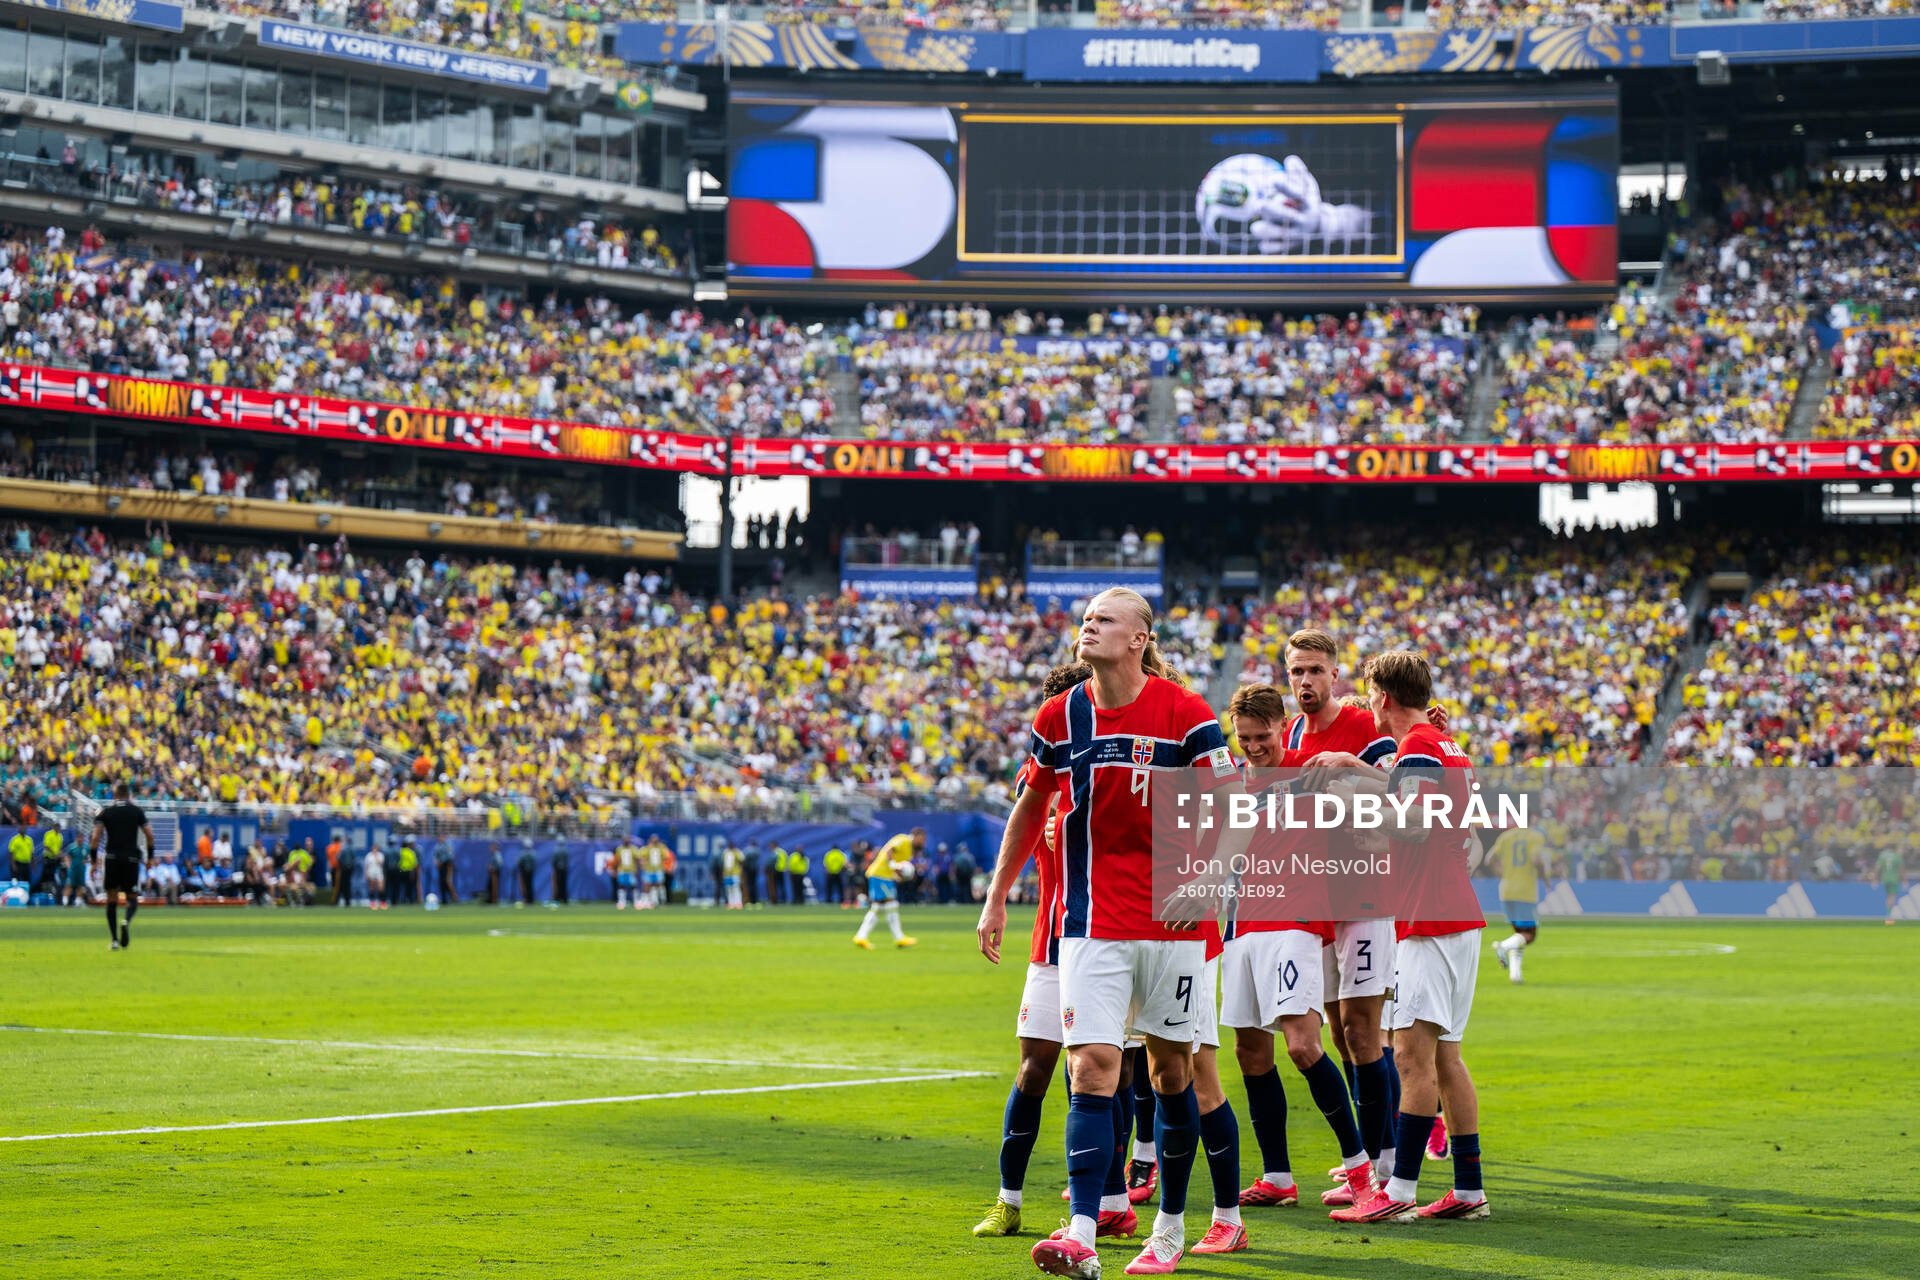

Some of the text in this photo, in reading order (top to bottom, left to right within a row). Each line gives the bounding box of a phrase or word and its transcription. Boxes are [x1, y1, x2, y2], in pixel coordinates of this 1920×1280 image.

[273, 25, 537, 84] NEW YORK NEW JERSEY
[1083, 38, 1260, 72] #FIFAWorldCup
[109, 379, 191, 417] NORWAY
[1569, 447, 1659, 478] NORWAY
[1131, 769, 1150, 807] 9
[1357, 939, 1371, 971] 3
[1175, 975, 1193, 1013] 9
[1277, 959, 1299, 993] 10
